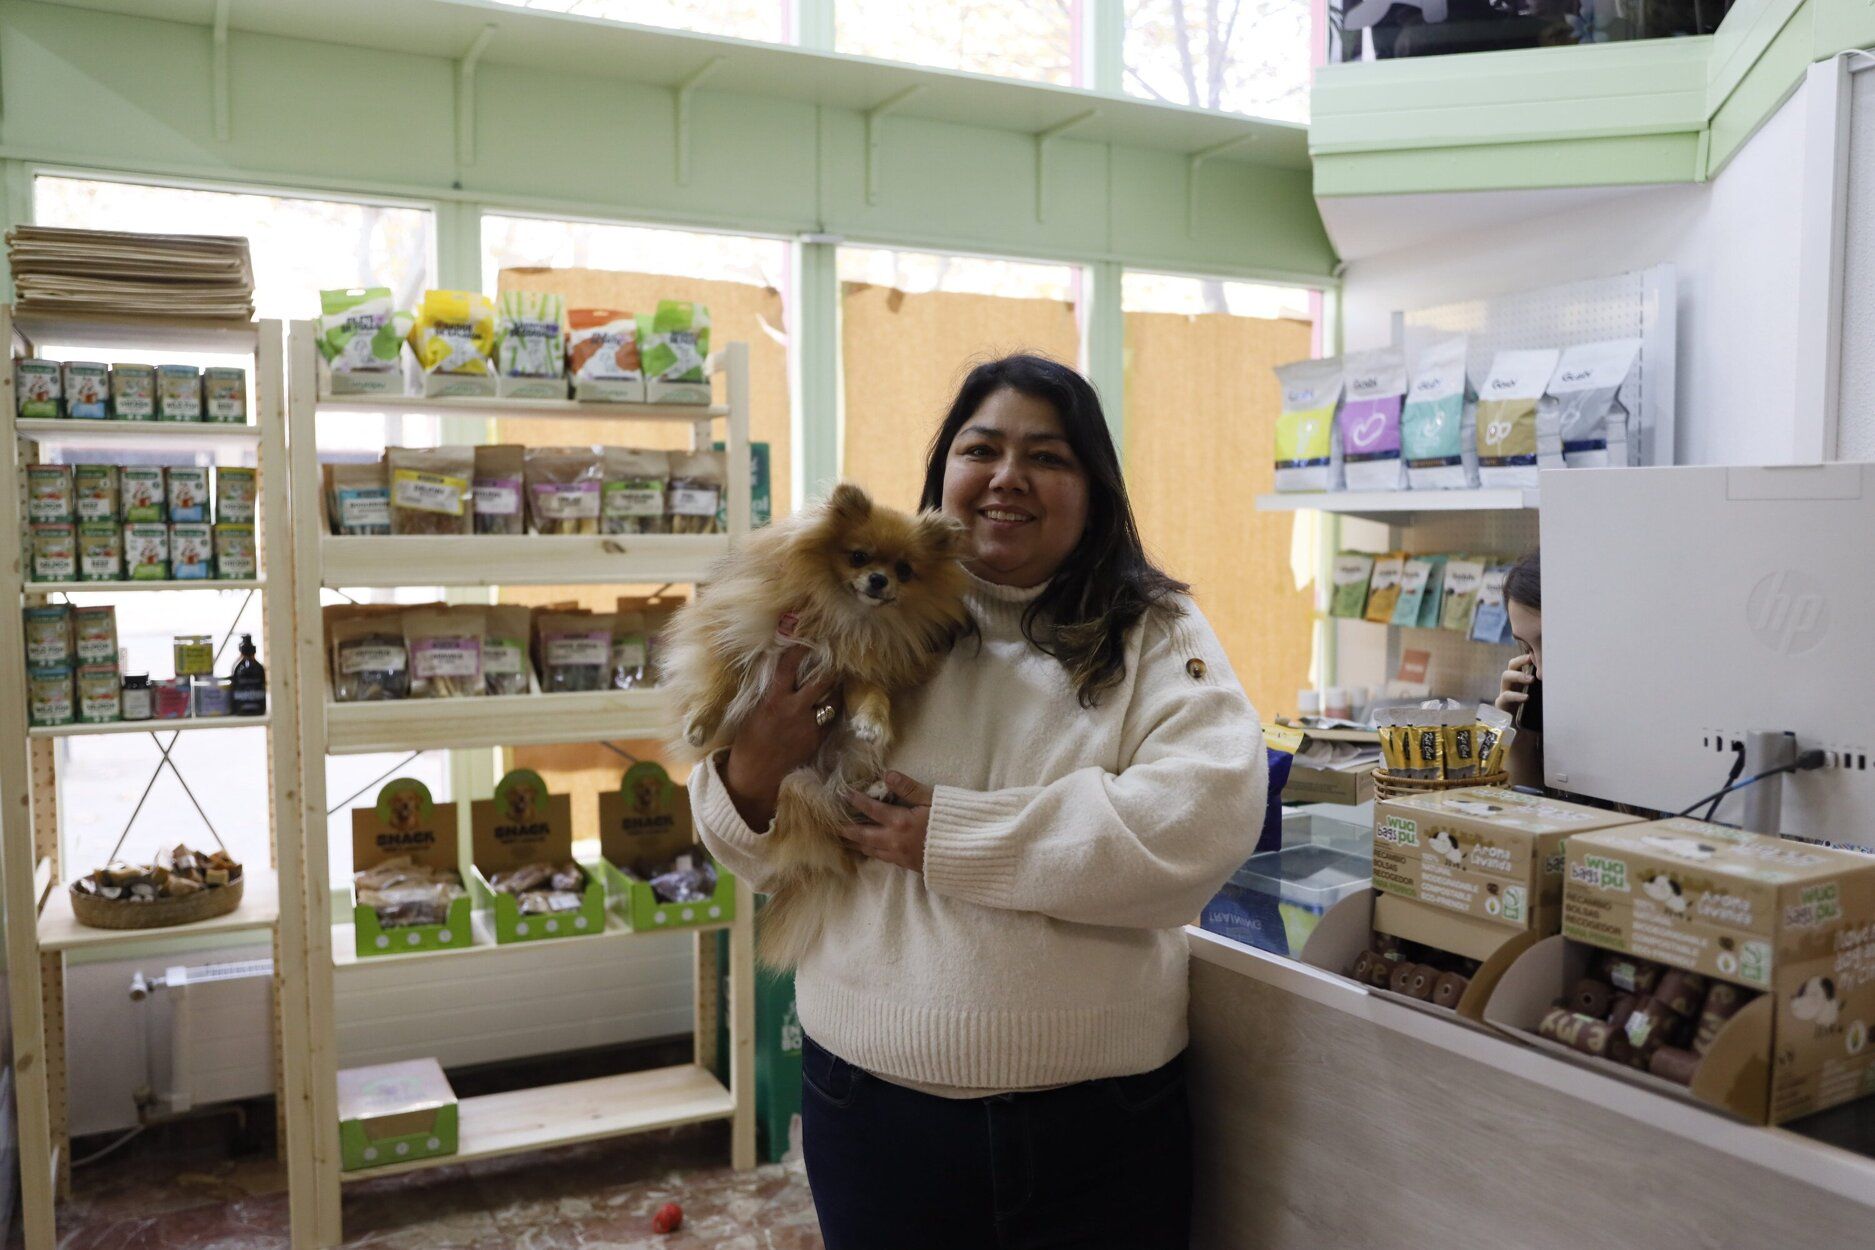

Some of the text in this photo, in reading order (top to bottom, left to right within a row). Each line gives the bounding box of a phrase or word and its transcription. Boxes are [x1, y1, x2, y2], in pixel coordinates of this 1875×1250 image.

[494, 821, 550, 839] SNACK
[1377, 823, 1397, 840] bags
[1387, 816, 1416, 832] wua
[376, 831, 436, 846] SNACK
[1585, 855, 1625, 875] wua
